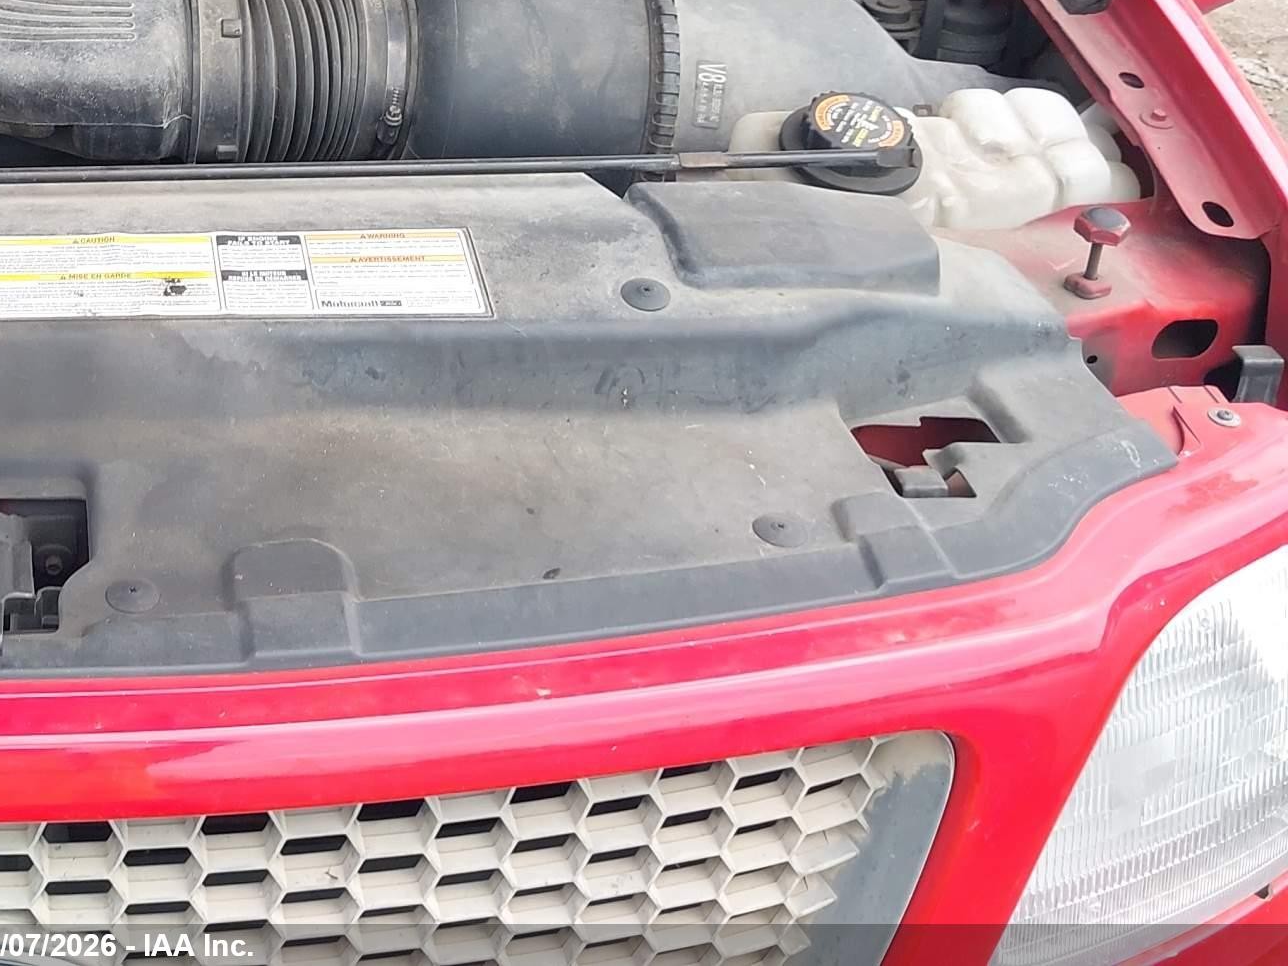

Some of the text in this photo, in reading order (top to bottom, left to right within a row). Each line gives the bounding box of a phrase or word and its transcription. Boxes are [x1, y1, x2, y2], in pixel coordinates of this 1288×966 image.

[698, 64, 727, 83] V8
[80, 236, 115, 244] CAUTION
[367, 232, 406, 240] WARNING
[358, 255, 425, 263] AVERTISSEMENT
